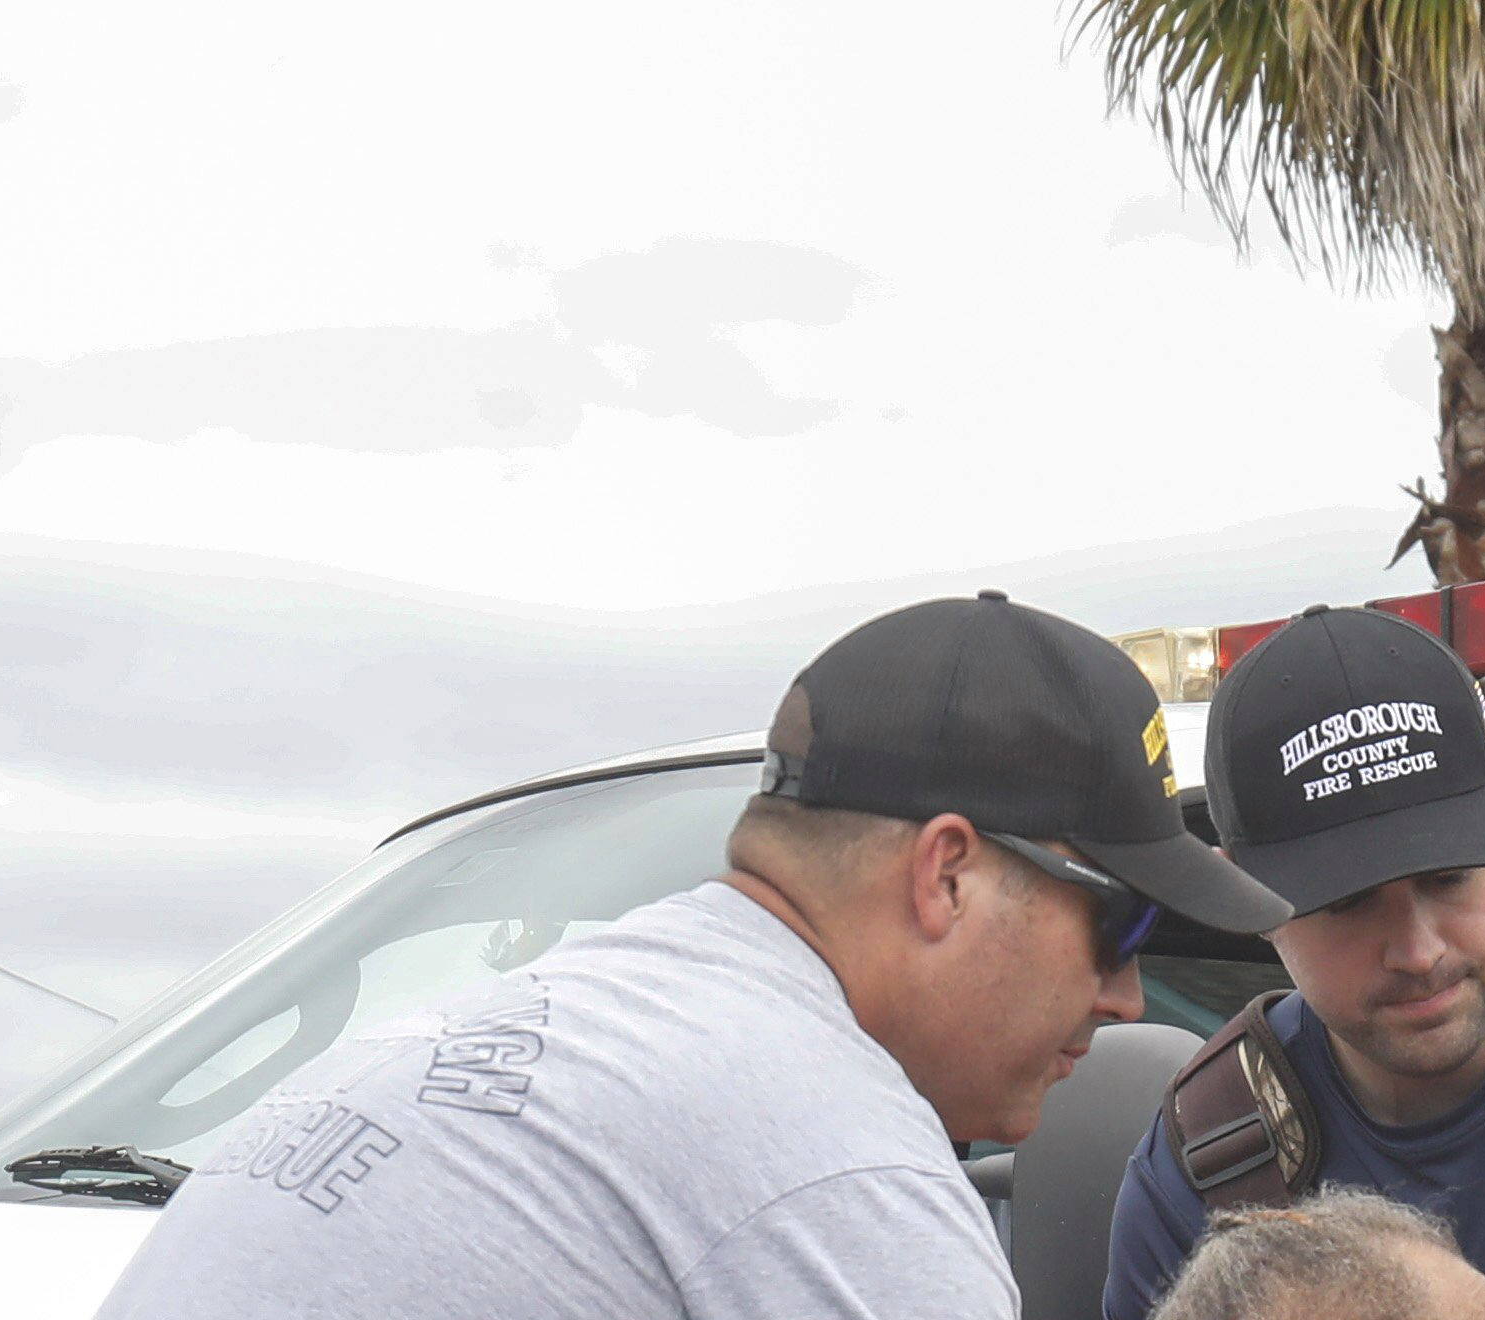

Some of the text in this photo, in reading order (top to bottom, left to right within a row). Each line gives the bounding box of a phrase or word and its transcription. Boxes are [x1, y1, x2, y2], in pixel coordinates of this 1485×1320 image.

[1280, 701, 1443, 776] HILLSBOROUGH
[1322, 735, 1411, 774] COUNTY
[1303, 751, 1437, 801] FIRE RESCUE
